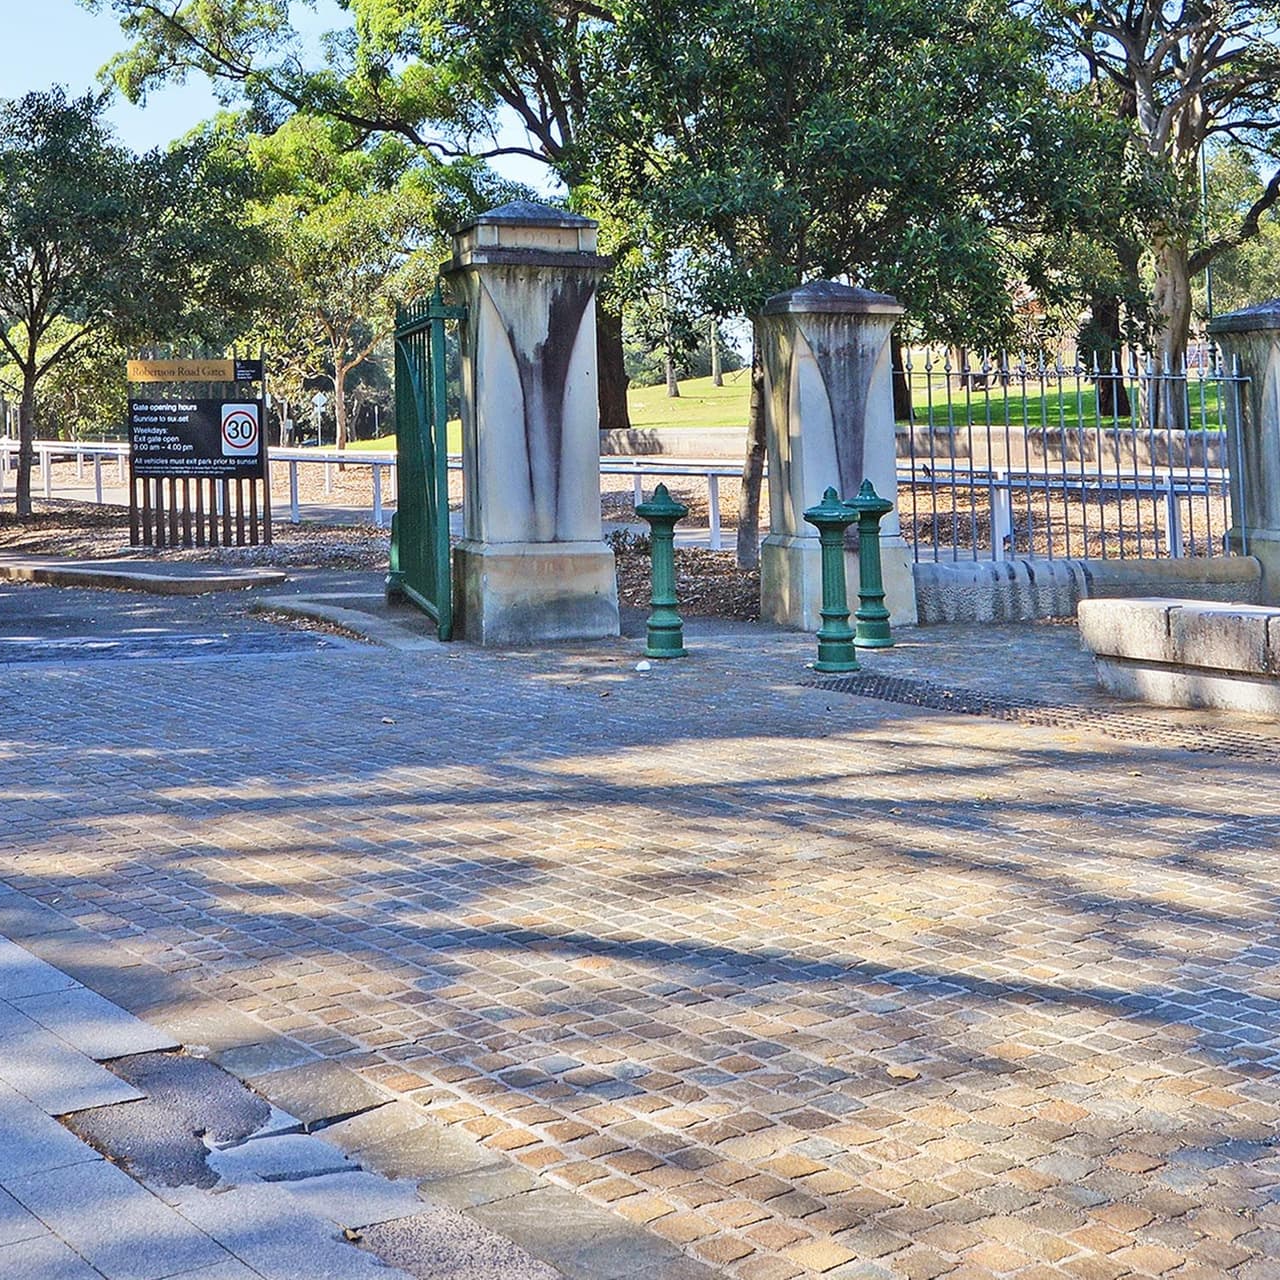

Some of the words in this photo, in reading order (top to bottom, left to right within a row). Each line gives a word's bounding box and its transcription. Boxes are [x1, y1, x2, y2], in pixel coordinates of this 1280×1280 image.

[132, 366, 175, 377] Robertson
[177, 366, 199, 376] Road
[201, 366, 226, 377] Gates
[132, 403, 148, 411] Gate
[149, 403, 177, 413] opening
[178, 403, 197, 411] hours
[133, 414, 158, 422] Sunrise
[227, 420, 253, 440] 30
[147, 436, 162, 444] gate
[182, 444, 193, 452] pm
[197, 458, 212, 466] park
[213, 458, 228, 466] prior
